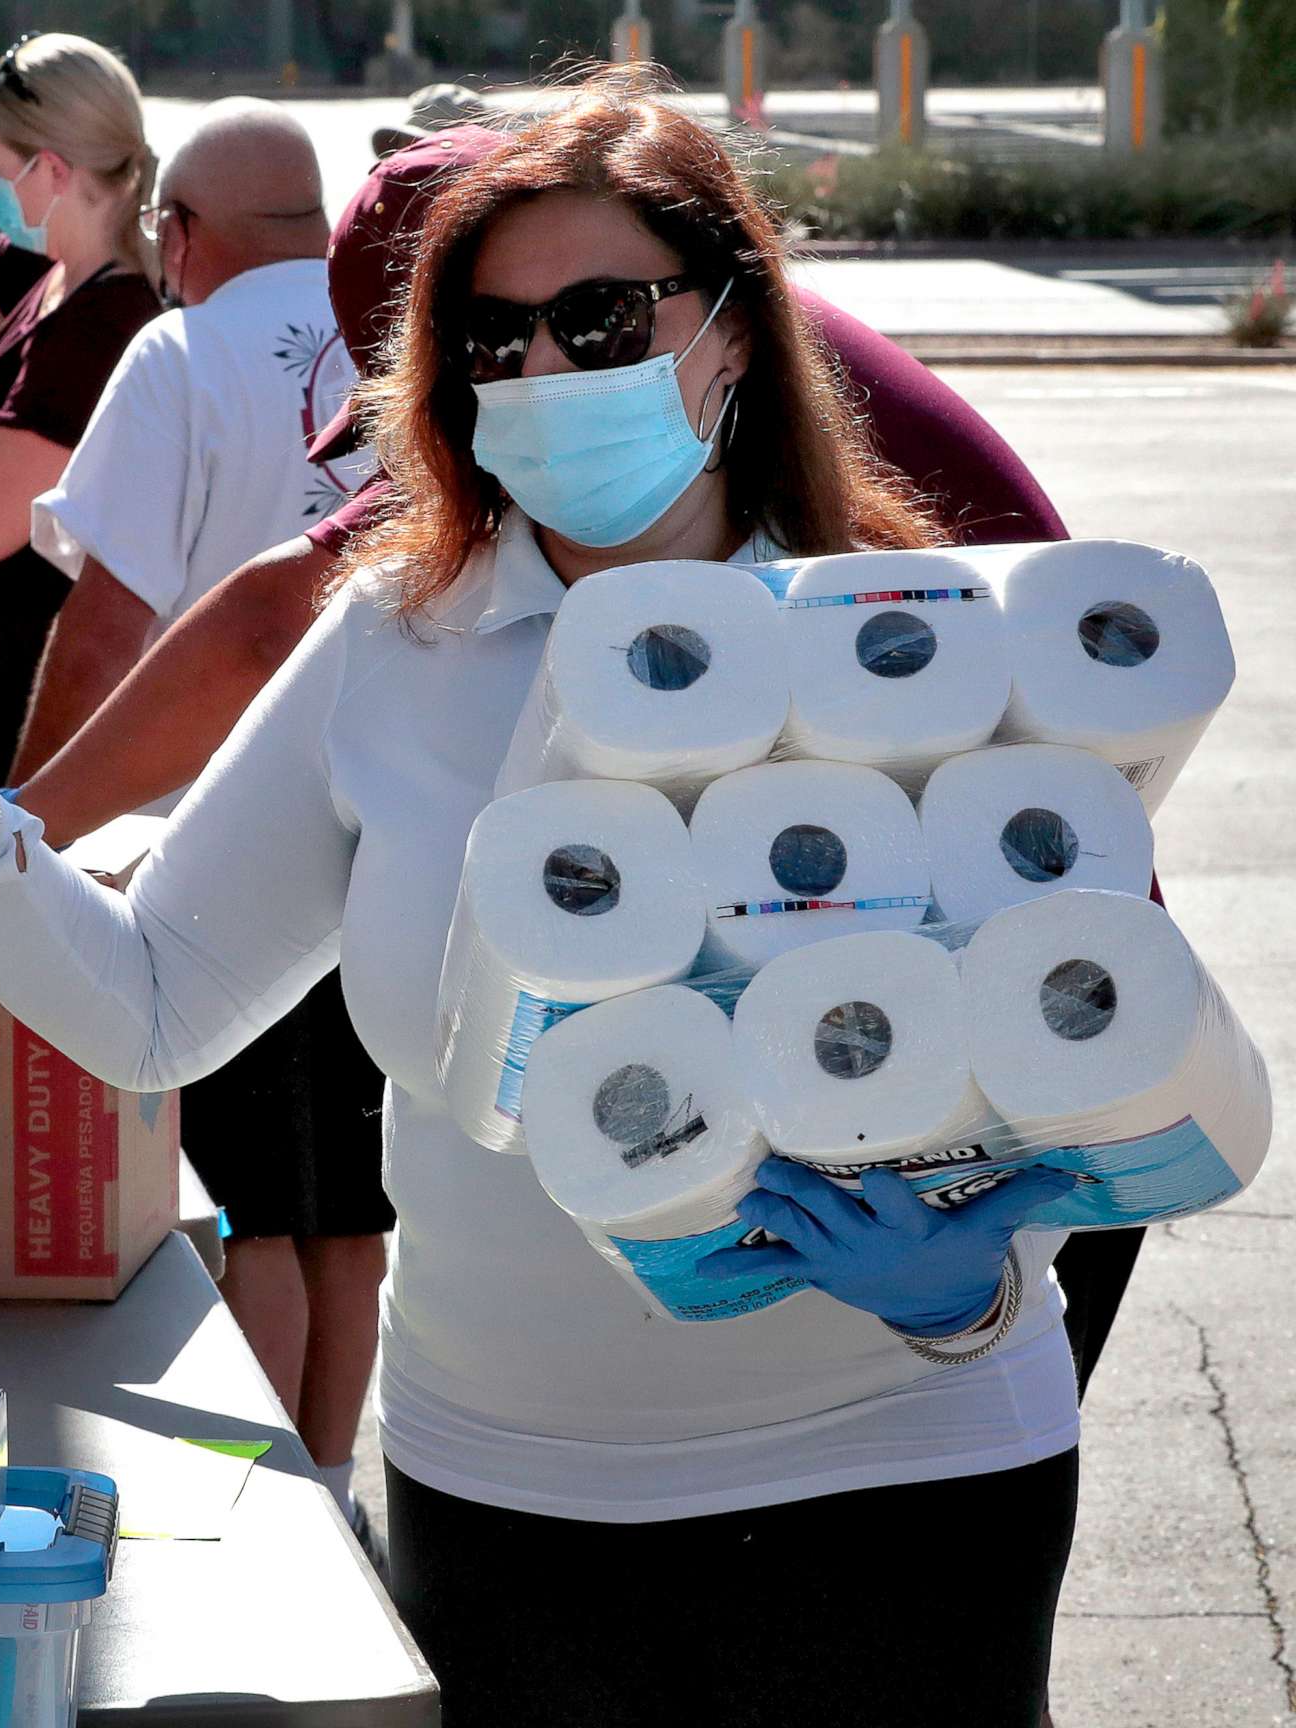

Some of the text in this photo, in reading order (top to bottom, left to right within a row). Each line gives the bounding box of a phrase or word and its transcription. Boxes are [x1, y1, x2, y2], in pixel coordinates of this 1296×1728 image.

[27, 1040, 51, 1258] HEAVY DUTY
[76, 1074, 95, 1259] PEQUEÑA PESADO
